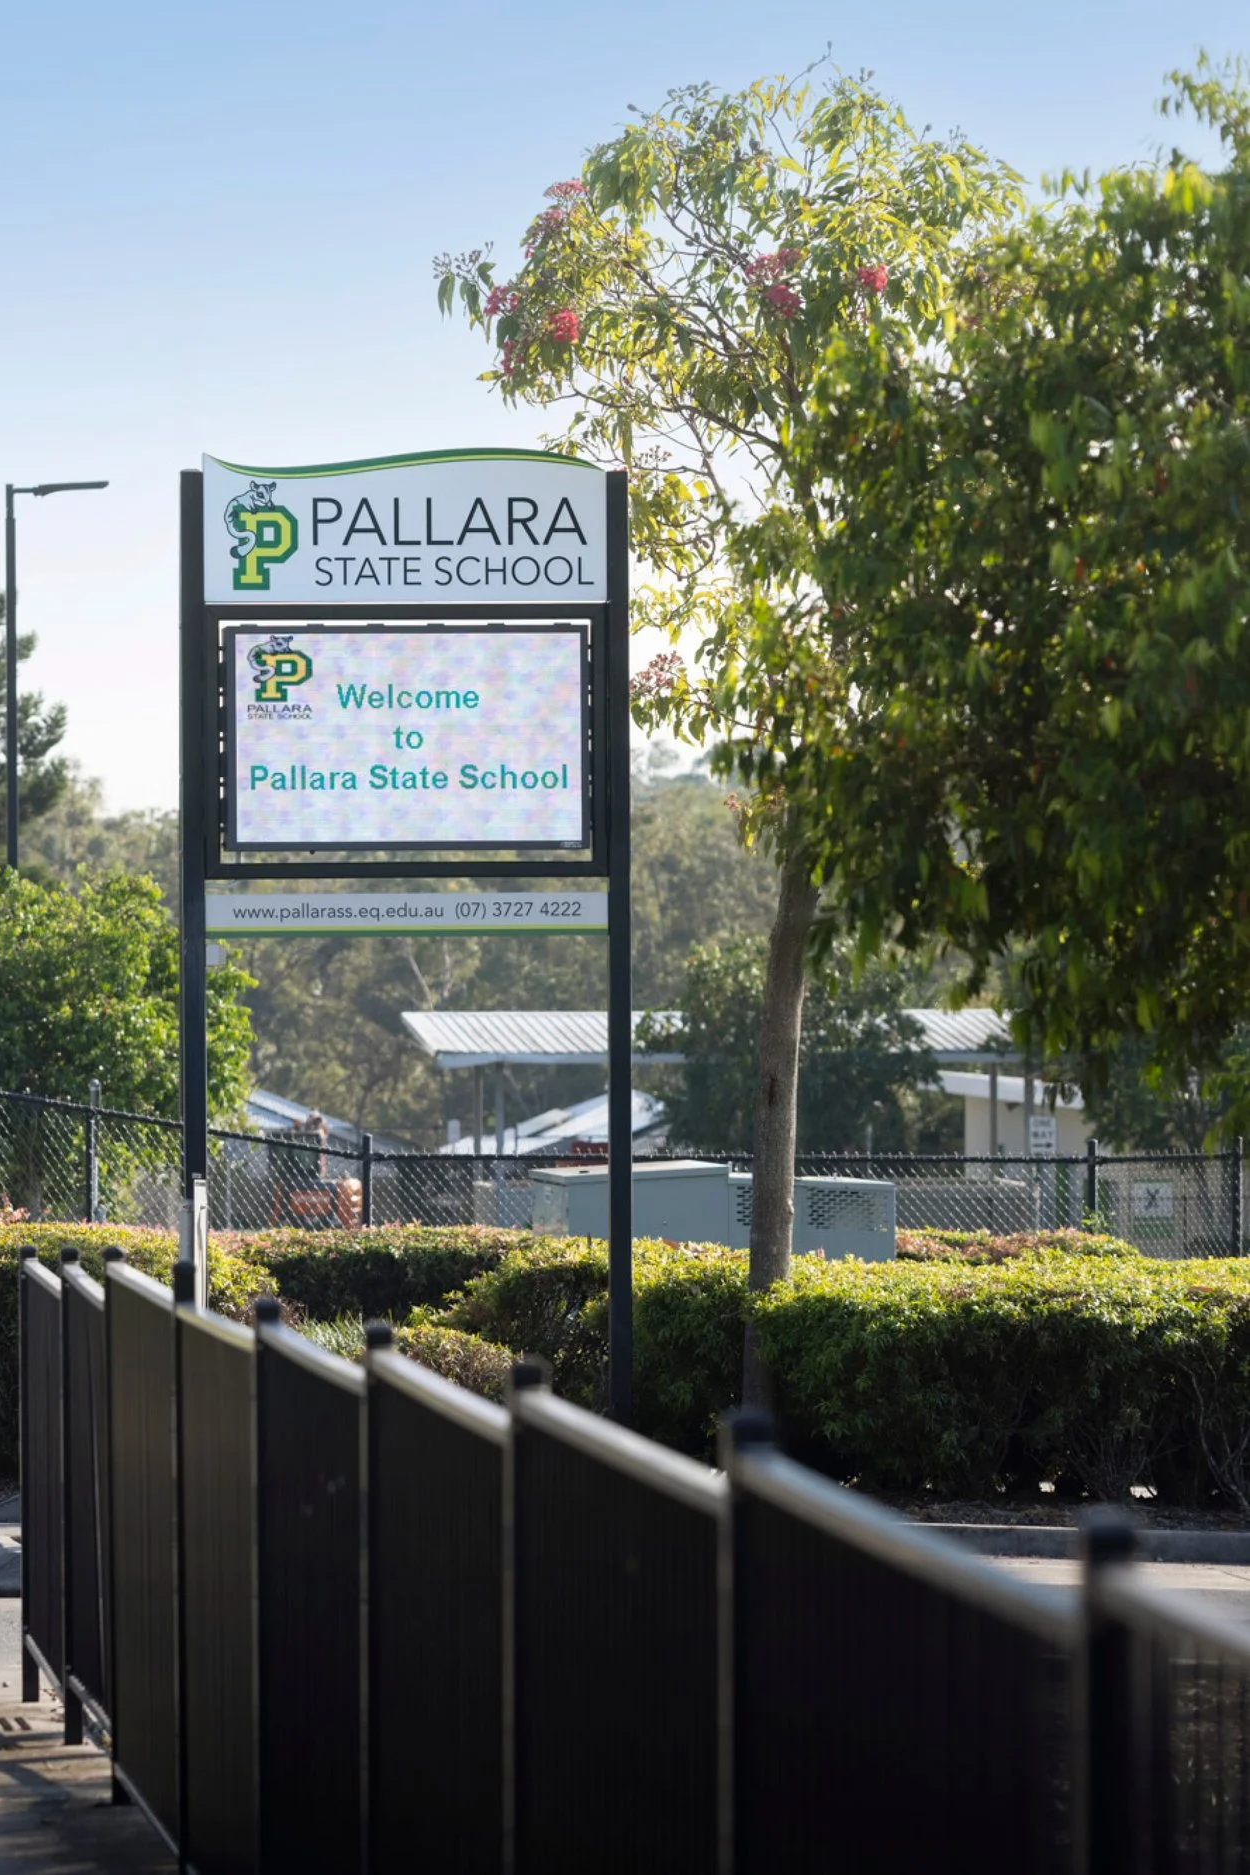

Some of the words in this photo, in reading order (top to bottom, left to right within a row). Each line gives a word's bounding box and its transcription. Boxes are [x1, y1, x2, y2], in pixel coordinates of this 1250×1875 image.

[312, 497, 588, 546] PALLARA
[314, 556, 423, 587] STATE
[434, 555, 595, 587] SCHOOL
[247, 704, 313, 713] PALLARA
[336, 683, 480, 709] Welcome
[392, 725, 424, 750] to
[250, 764, 358, 791] Pallara
[368, 763, 449, 790] State
[459, 763, 568, 790] School
[232, 902, 445, 923] www.pallarass.eq.edu.au
[455, 901, 487, 920] (07)
[492, 901, 534, 918] 3727
[539, 900, 582, 917] 4222
